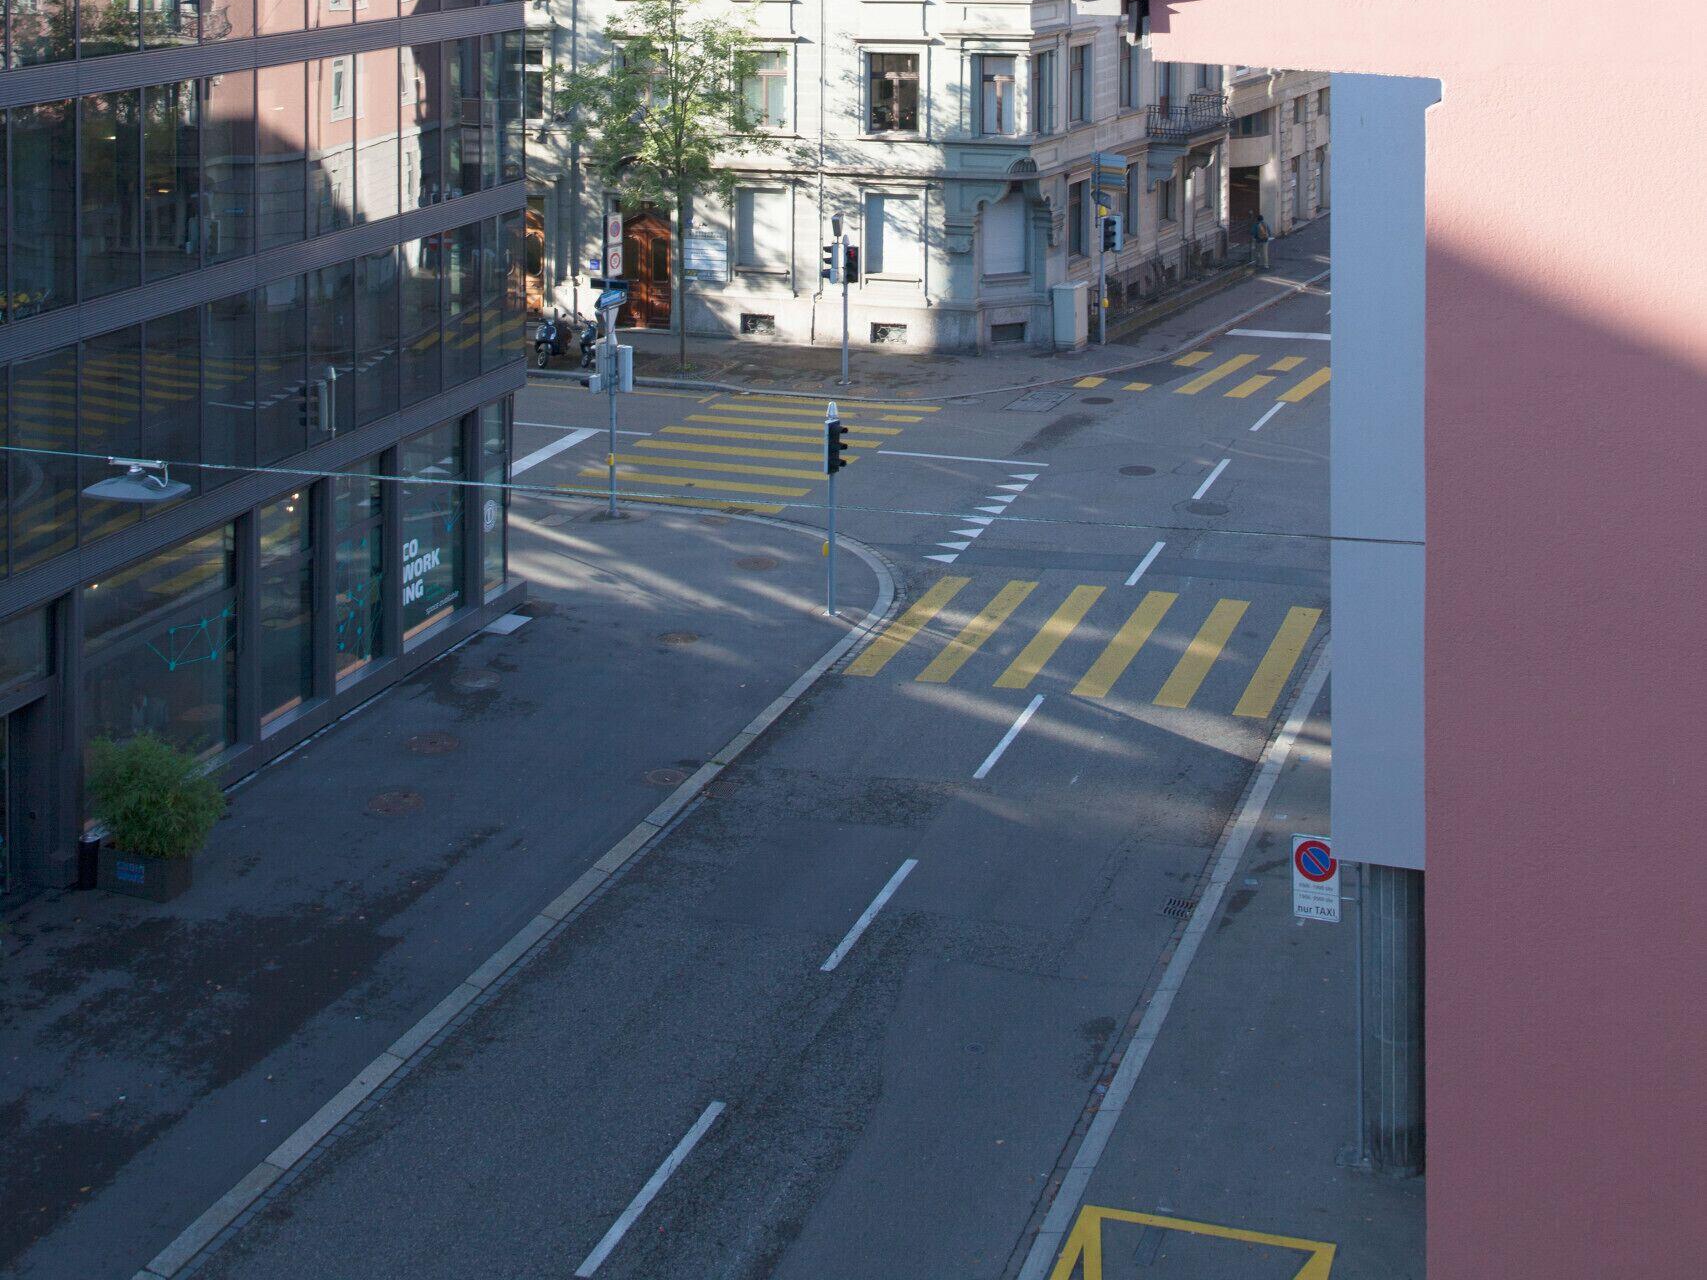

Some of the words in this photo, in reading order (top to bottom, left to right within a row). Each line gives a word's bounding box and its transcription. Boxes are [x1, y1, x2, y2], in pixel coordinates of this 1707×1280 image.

[403, 538, 418, 561] CO
[403, 547, 440, 583] WORK
[403, 578, 424, 606] ING
[1297, 905, 1313, 913] nur
[1315, 906, 1336, 917] TAXI
